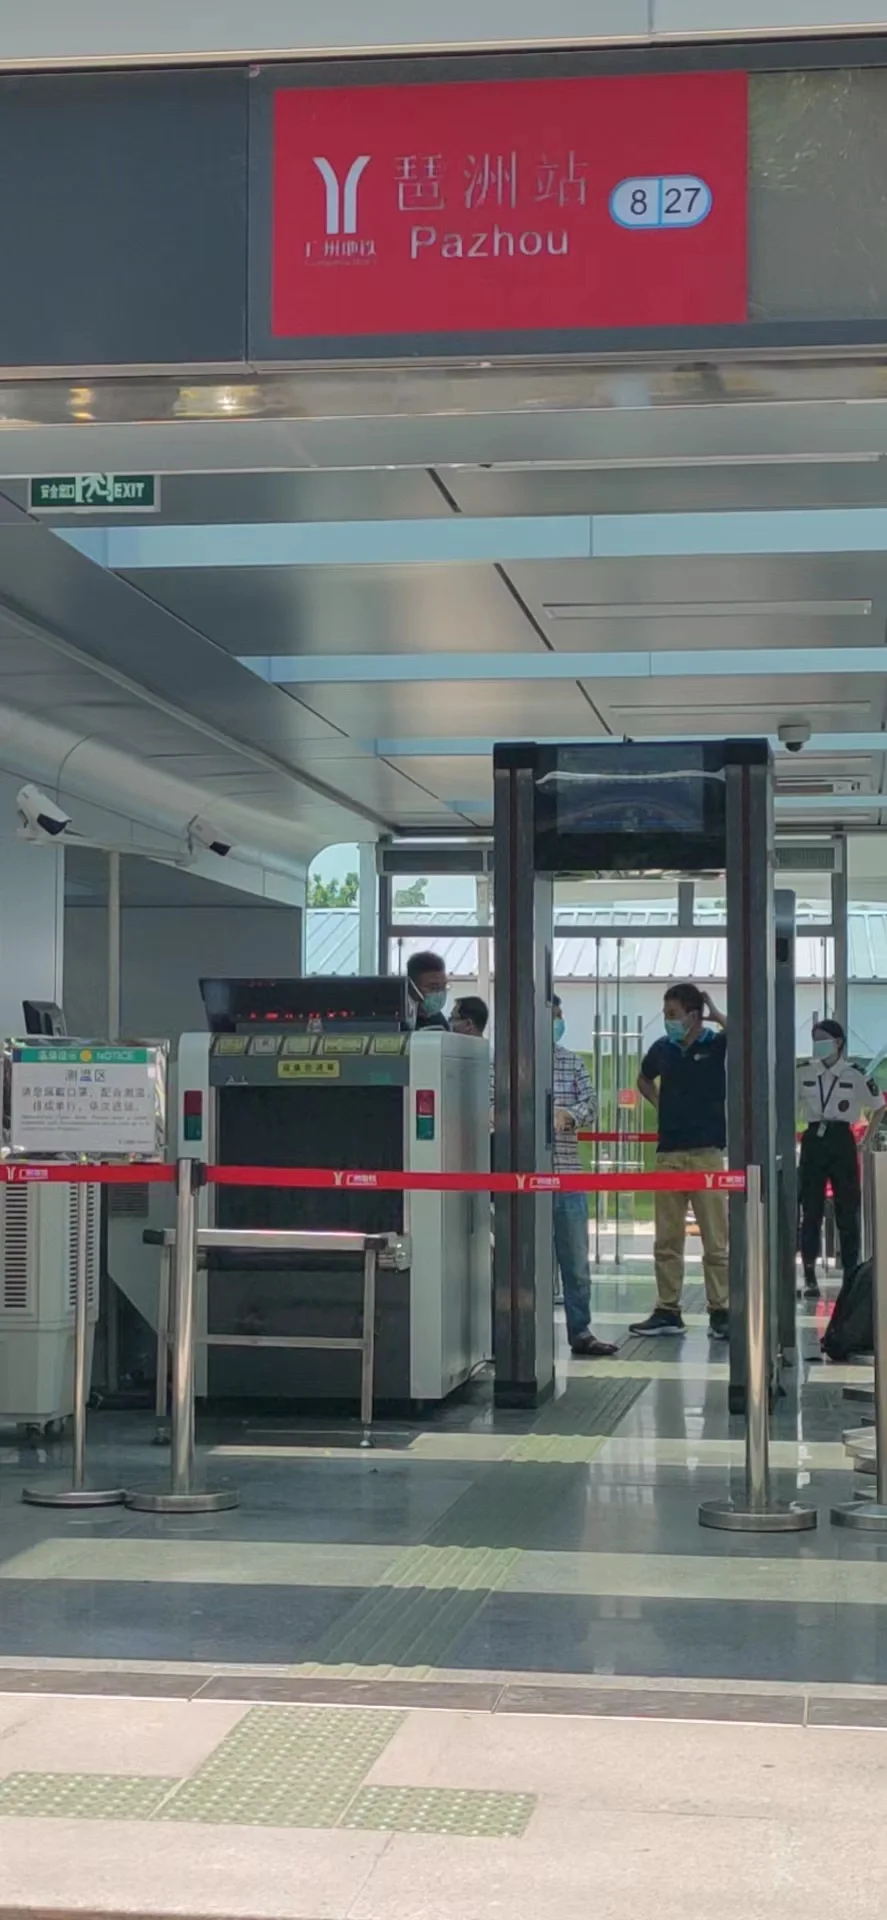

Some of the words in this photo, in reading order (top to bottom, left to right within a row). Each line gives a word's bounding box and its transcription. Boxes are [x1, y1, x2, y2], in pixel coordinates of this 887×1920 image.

[393, 150, 588, 211] 琶洲站
[630, 189, 647, 215] 8
[664, 187, 701, 213] 27
[410, 224, 568, 259] Pazhou
[114, 482, 145, 498] EXIT
